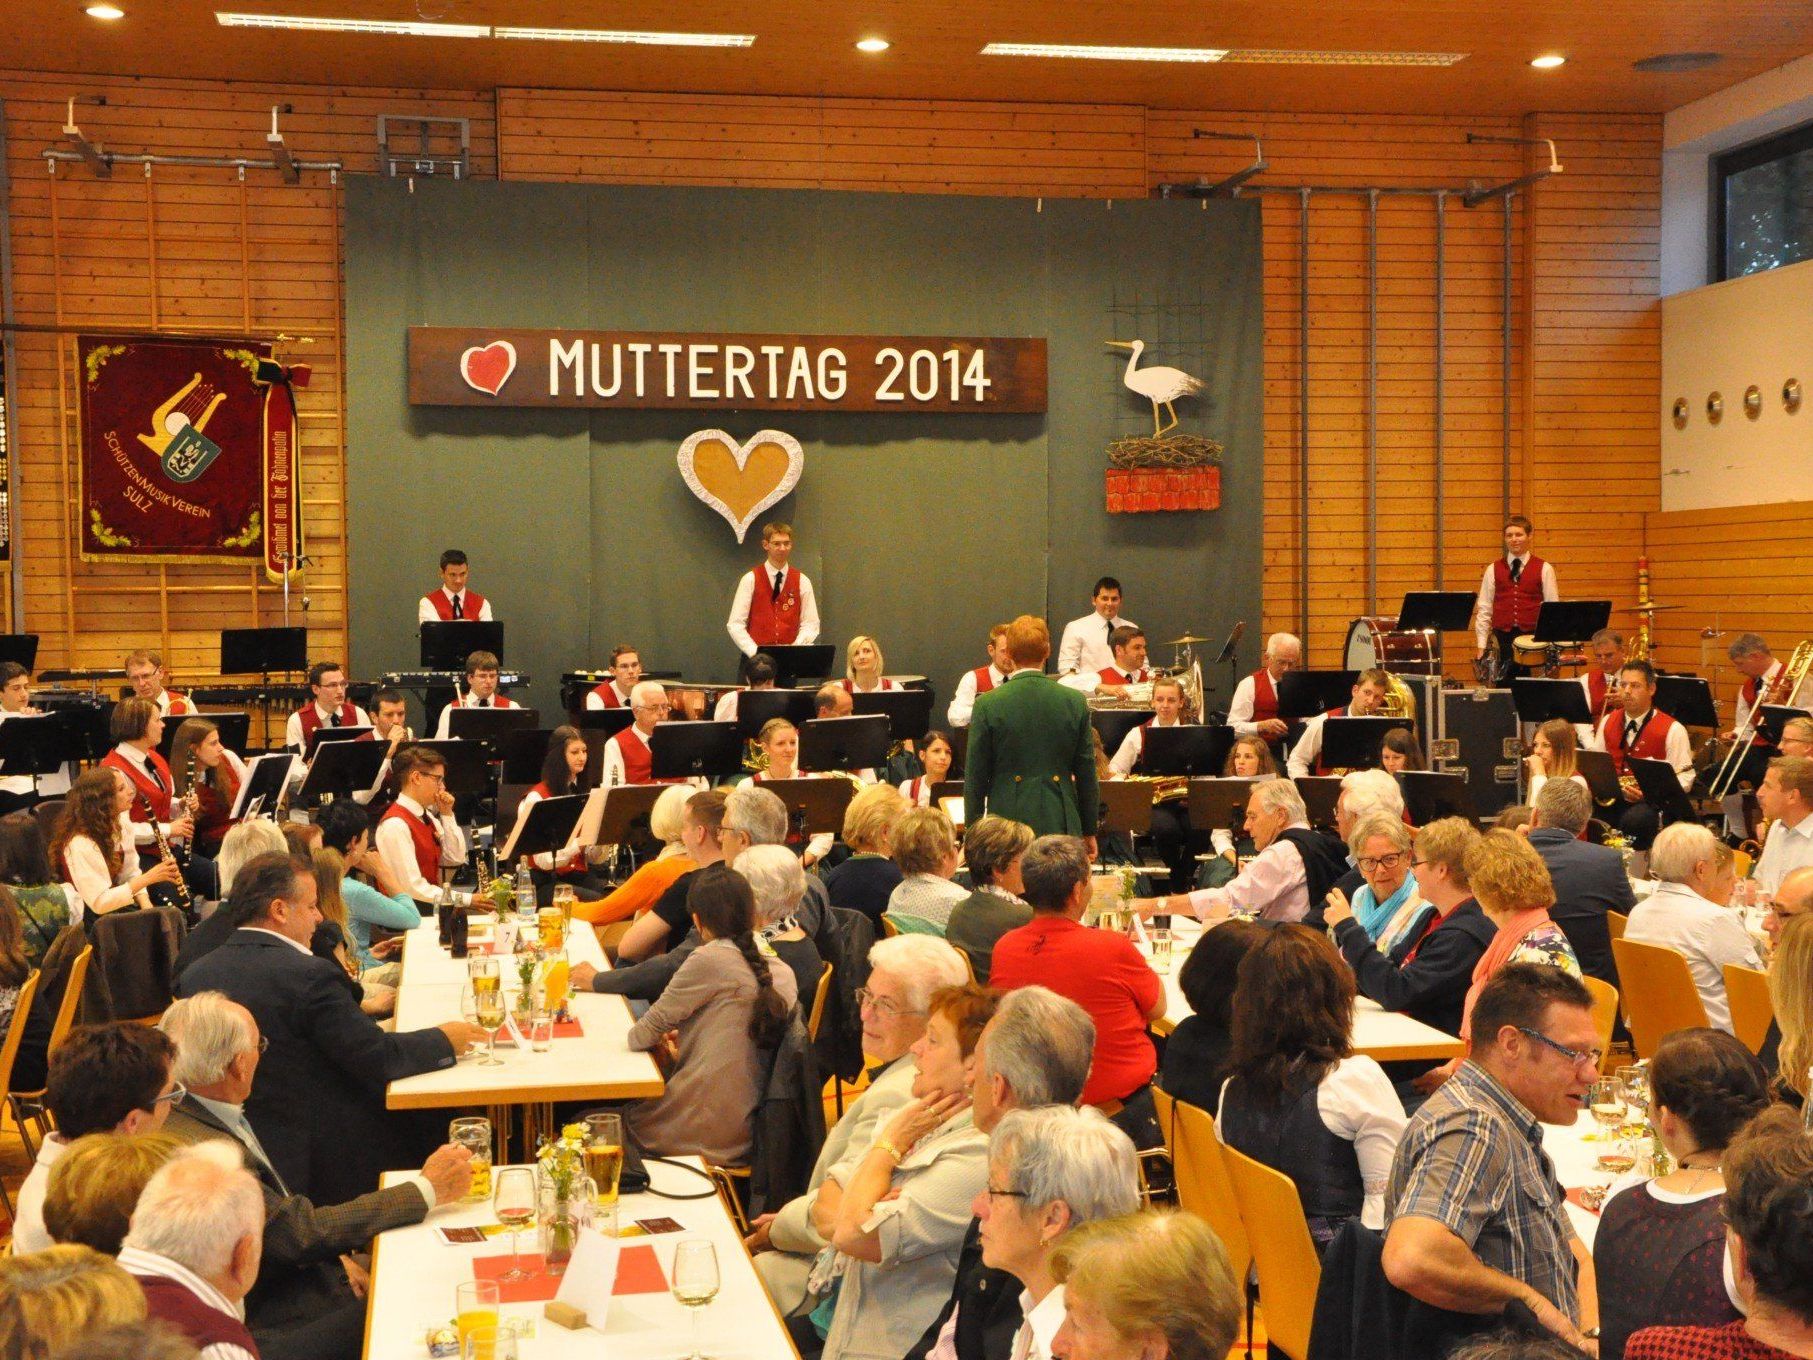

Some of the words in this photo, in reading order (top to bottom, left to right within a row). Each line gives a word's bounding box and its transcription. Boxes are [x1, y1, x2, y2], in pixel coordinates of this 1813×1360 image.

[549, 338, 848, 400] MUTTERTAG
[874, 347, 992, 402] 2014
[122, 485, 153, 513] SULZ
[271, 485, 287, 499] der
